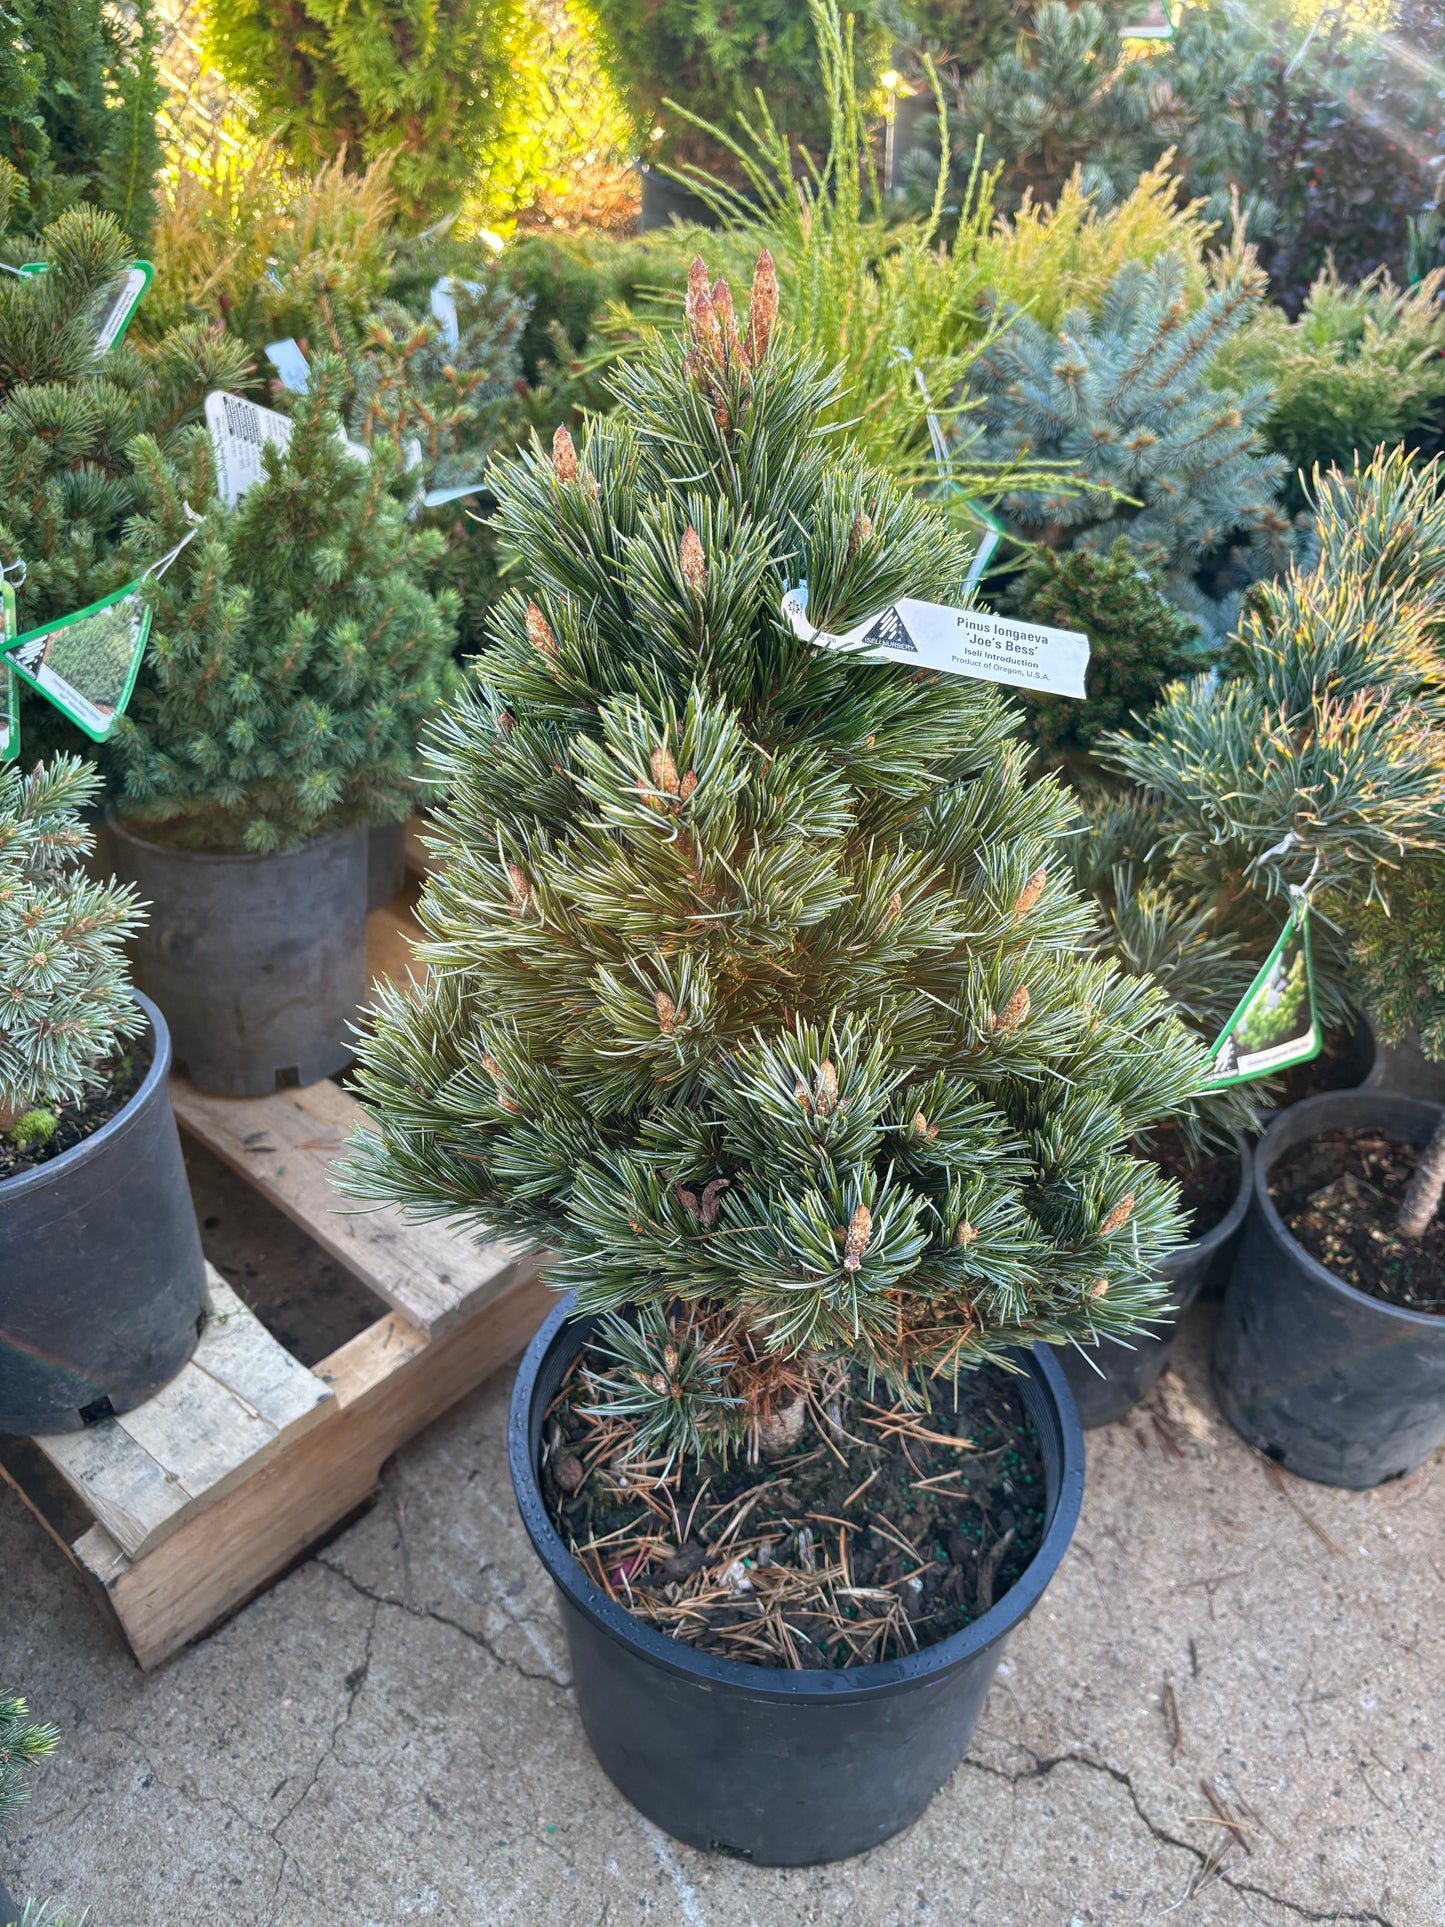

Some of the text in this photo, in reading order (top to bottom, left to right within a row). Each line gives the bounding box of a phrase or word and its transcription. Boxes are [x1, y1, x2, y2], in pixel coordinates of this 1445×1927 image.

[956, 616, 1049, 645] Pinus longaeva
[882, 640, 915, 652] NURSERY
[966, 632, 1038, 656] 'Joe's Bess'
[951, 655, 982, 668] Product
[993, 663, 1025, 677] Oregon,
[1026, 670, 1051, 681] U.S.A.
[964, 647, 1039, 669] Iseli Introduction
